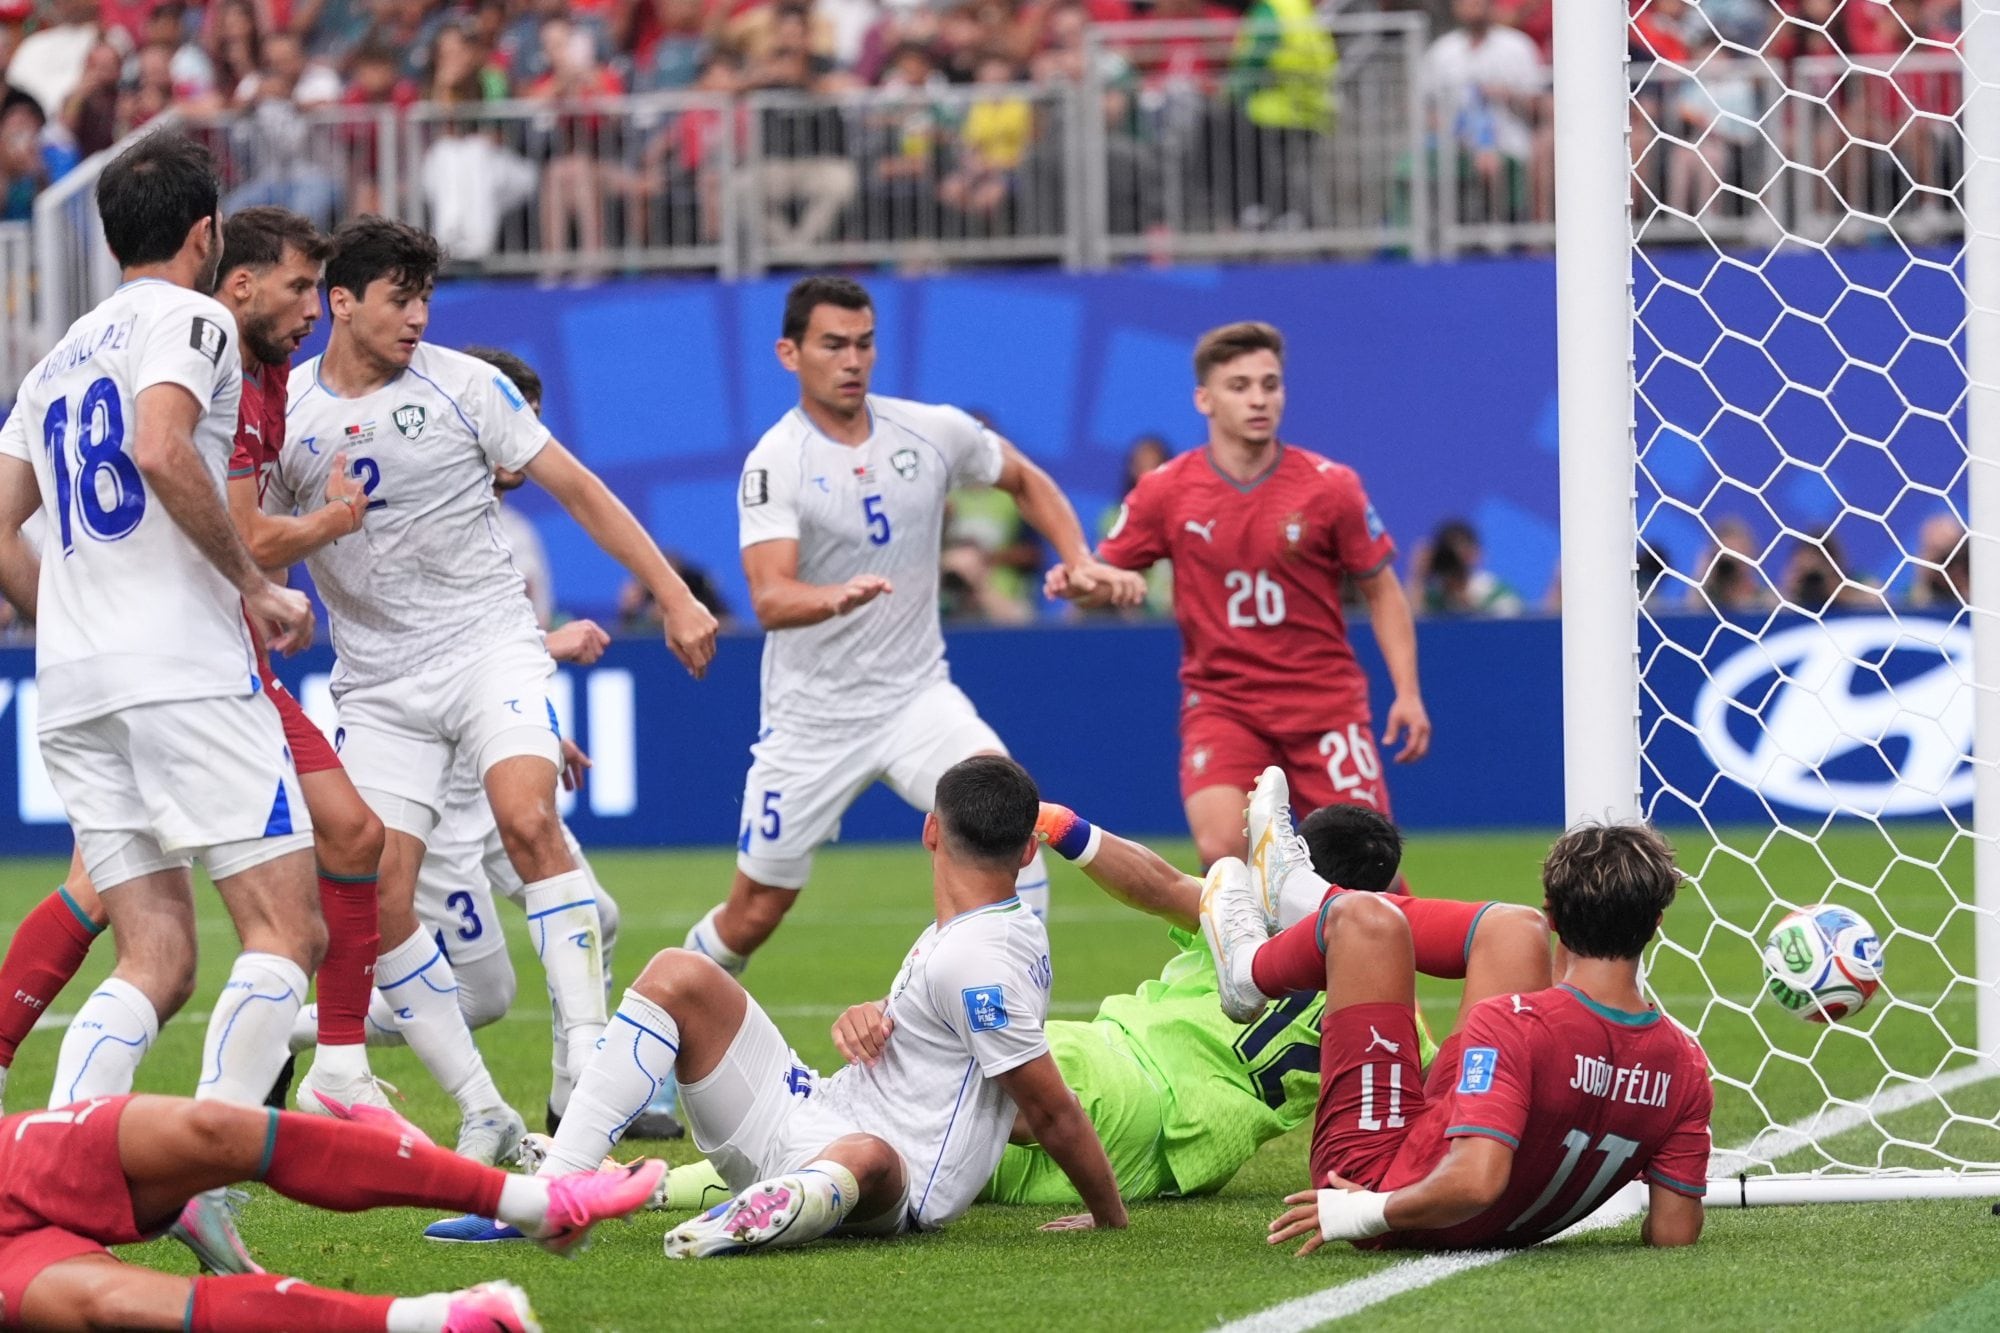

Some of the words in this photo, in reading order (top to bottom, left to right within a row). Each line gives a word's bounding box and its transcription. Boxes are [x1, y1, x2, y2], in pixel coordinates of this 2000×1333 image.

[43, 377, 146, 560] 18
[350, 457, 388, 511] 2
[863, 494, 891, 546] 5
[1224, 568, 1287, 628] 26
[1318, 722, 1380, 792] 26
[761, 790, 782, 841] 5
[445, 890, 483, 942] 3
[1358, 1063, 1405, 1131] 11
[1611, 1062, 1672, 1108] FÉLIX
